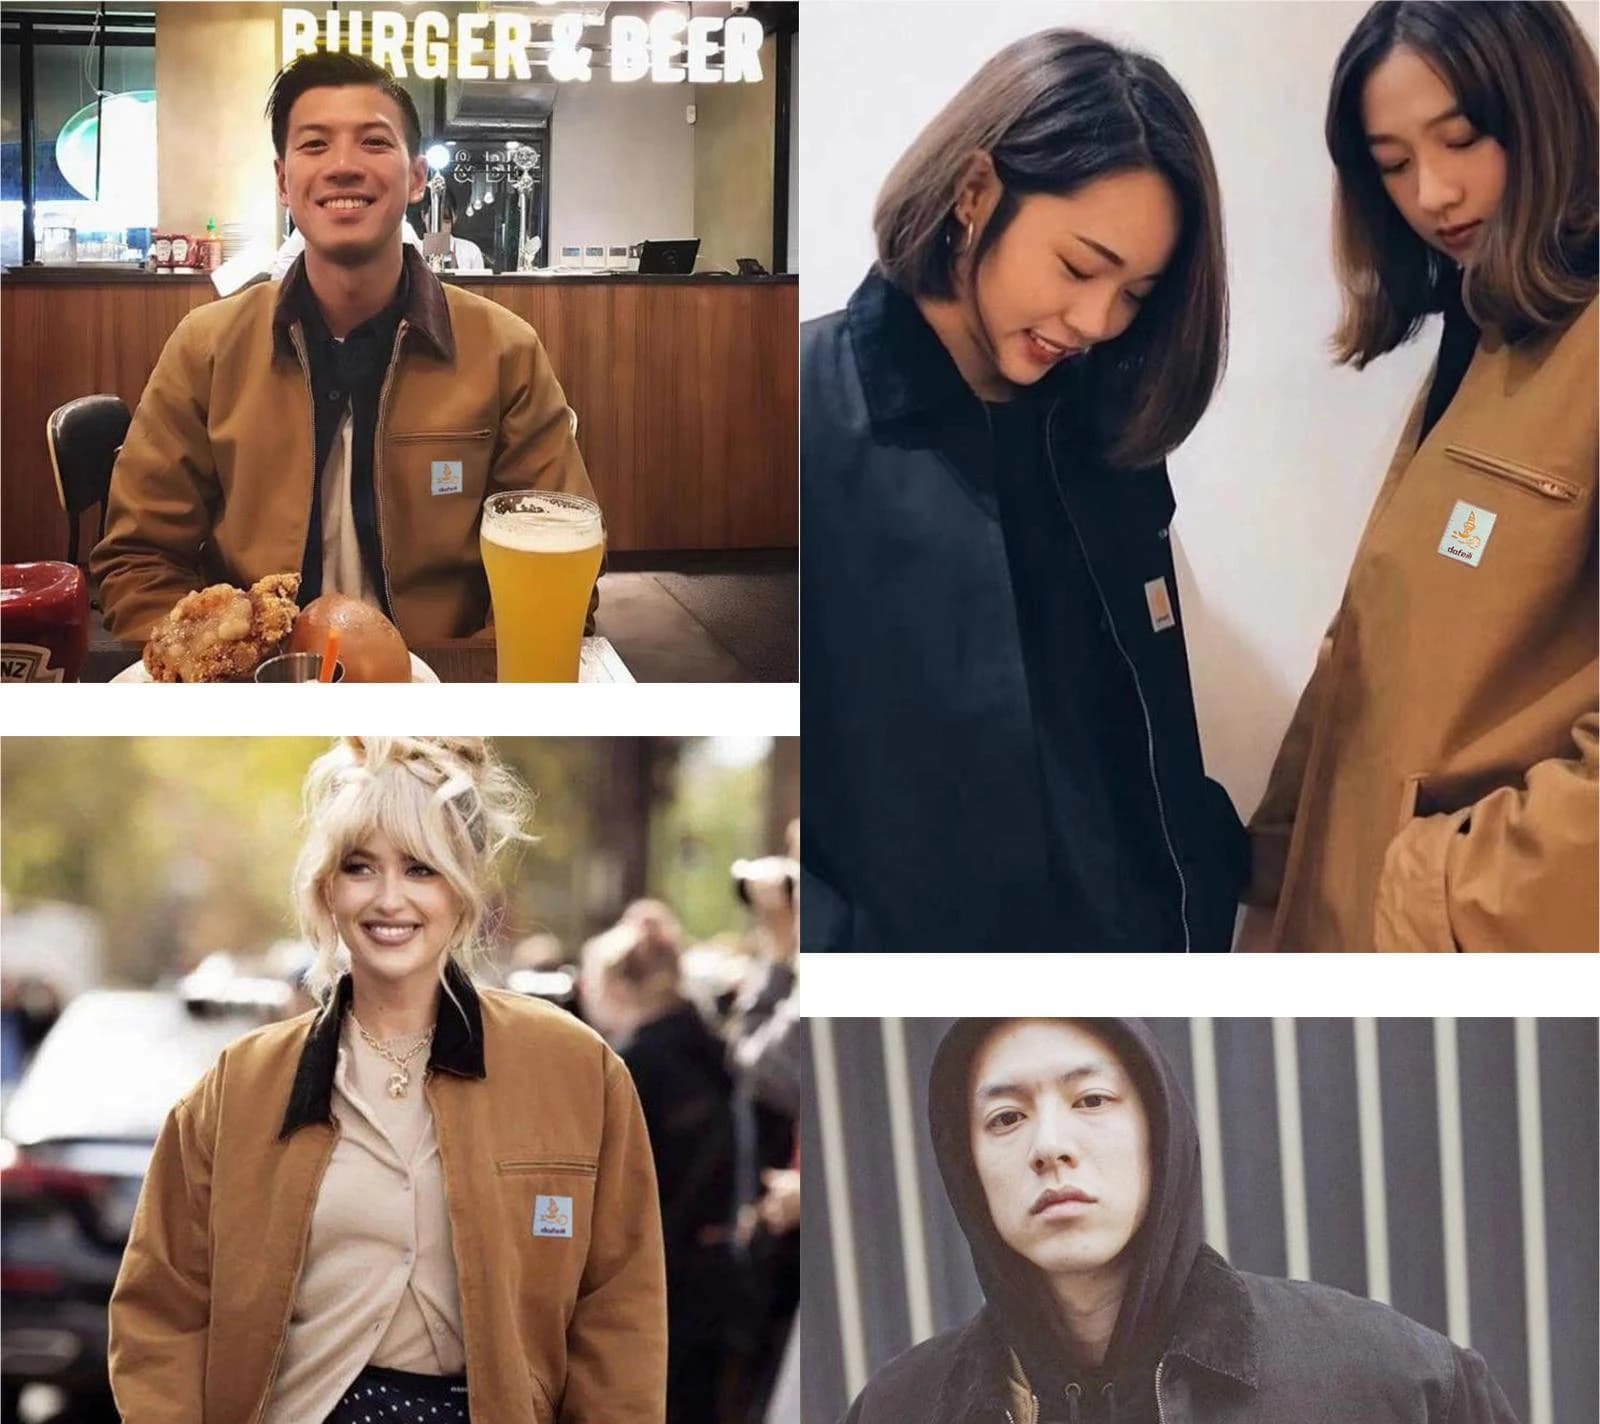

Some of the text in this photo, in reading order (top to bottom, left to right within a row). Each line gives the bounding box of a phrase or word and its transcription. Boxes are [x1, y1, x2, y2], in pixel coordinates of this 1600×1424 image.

[281, 9, 764, 83] BURGER & BEER
